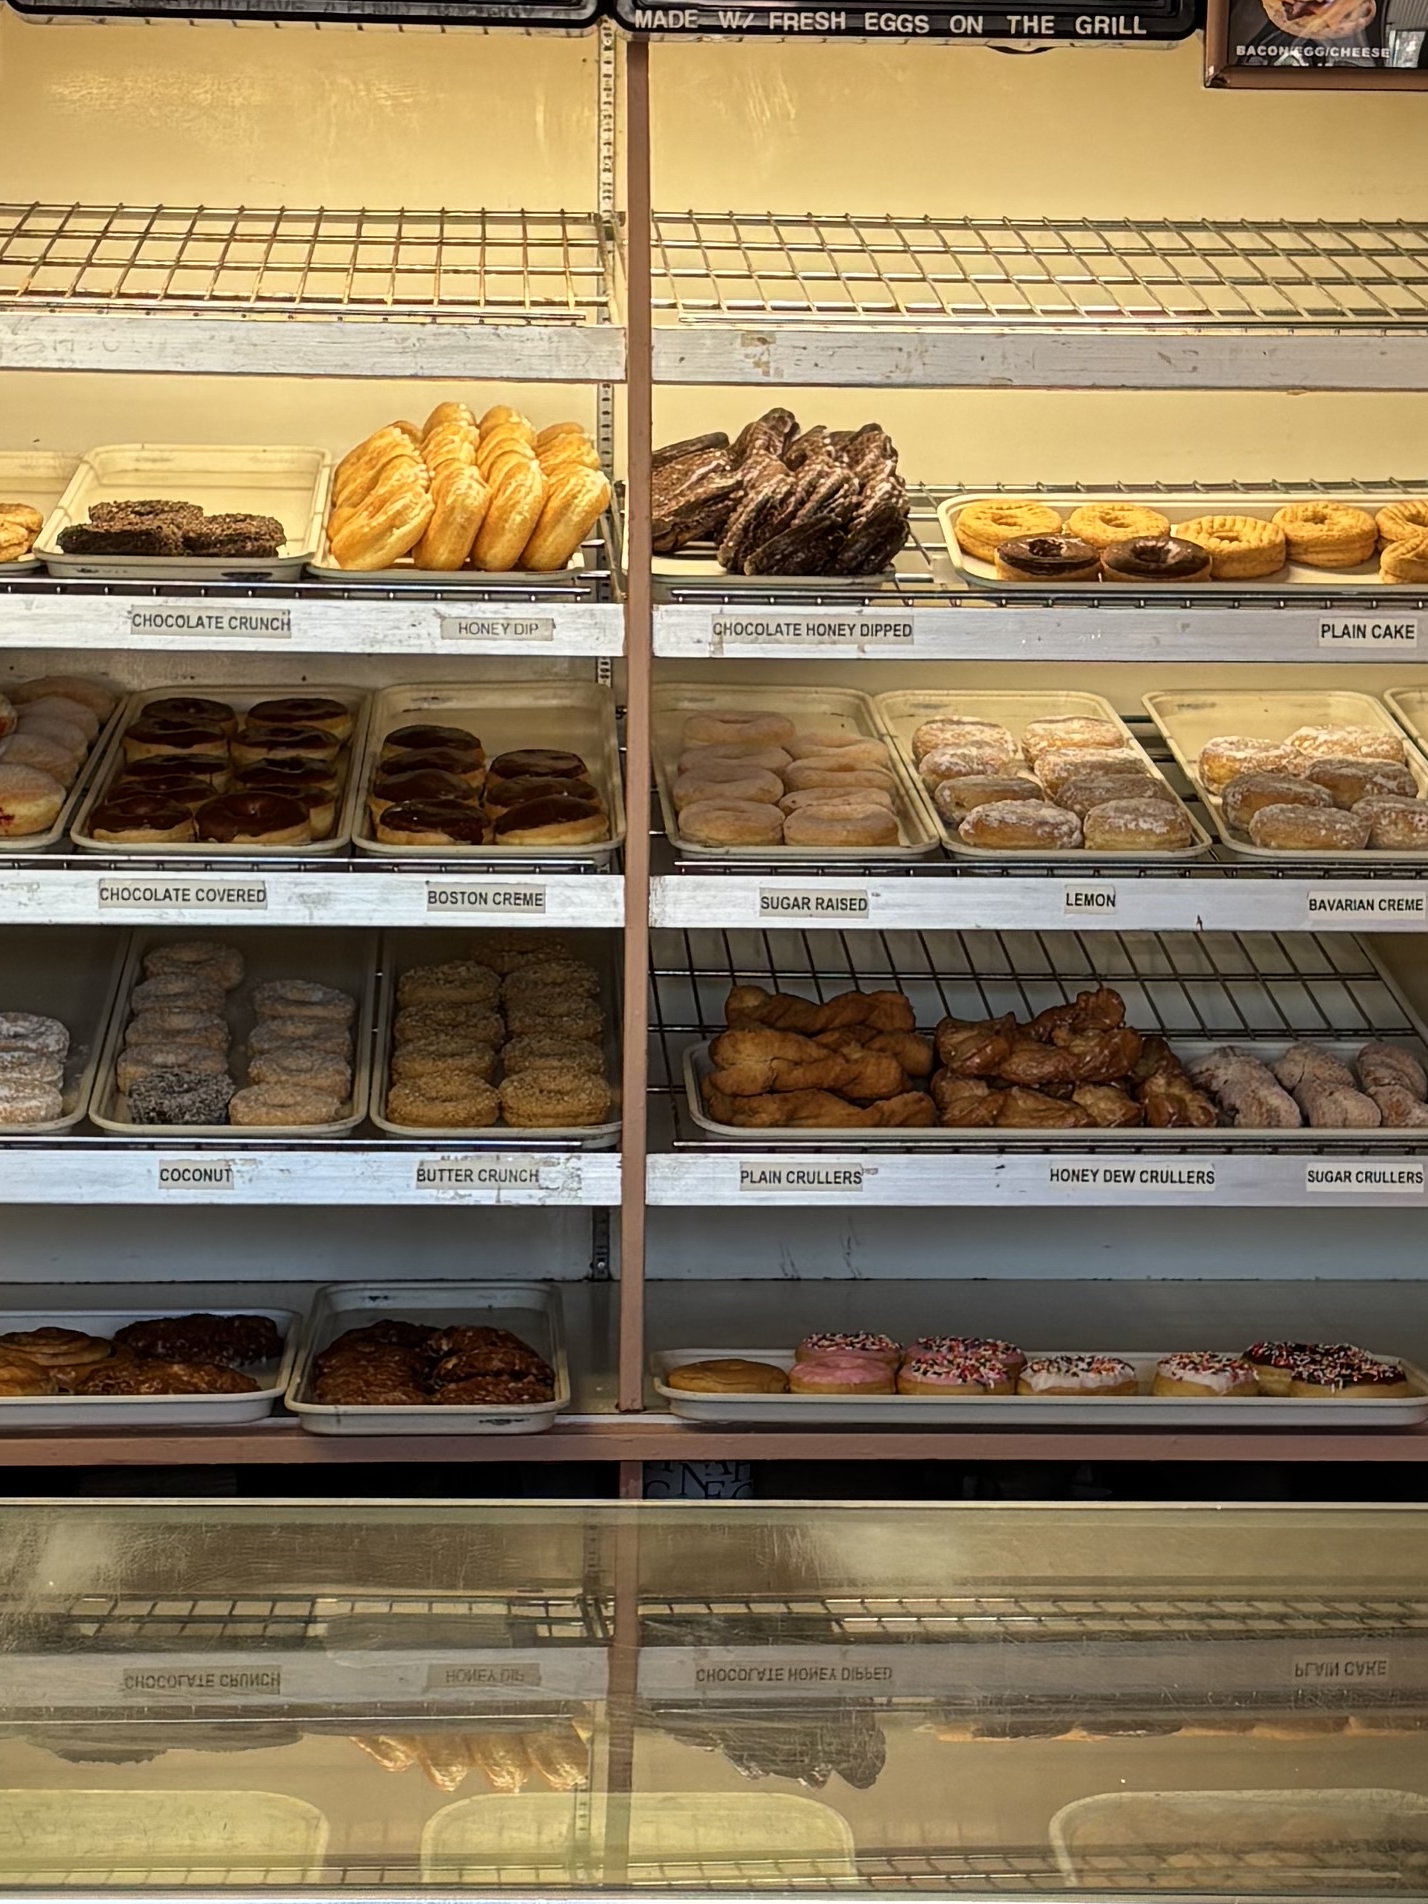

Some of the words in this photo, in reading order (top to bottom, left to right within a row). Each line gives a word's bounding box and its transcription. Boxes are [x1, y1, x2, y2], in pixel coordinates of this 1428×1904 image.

[635, 9, 698, 30] MADE
[769, 10, 846, 31] FRESH
[864, 12, 929, 34] EGGS
[949, 13, 983, 35] ON
[1007, 15, 1055, 35] THE
[1075, 16, 1147, 36] GRILL
[132, 613, 224, 630] CHOCOLATE
[228, 614, 291, 632] CRUNCH
[458, 621, 509, 635] HONEY
[514, 622, 539, 636] DIP
[713, 621, 802, 637] CHOCOLATE
[805, 622, 856, 638] HONEY
[860, 623, 913, 639] DIPPED
[1321, 624, 1366, 640] PLAIN
[1372, 624, 1415, 640] CAKE
[99, 887, 191, 903] CHOCOLATE
[195, 887, 266, 903] COVERED
[427, 890, 488, 906] BOSTON
[492, 891, 544, 907] CREME
[1066, 893, 1116, 907] LEMON
[760, 896, 811, 911] SUGAR
[815, 896, 868, 912] RAISED
[1309, 898, 1374, 911] BAVARIAN
[1378, 899, 1424, 911] CREME
[160, 1168, 232, 1182] COCONUT
[416, 1168, 474, 1182] BUTTER
[478, 1168, 539, 1182] CRUNCH
[740, 1171, 782, 1184] PLAIN
[786, 1171, 862, 1184] CRULLERS
[1050, 1168, 1099, 1183] HONEY
[1103, 1169, 1136, 1183] DEW
[1139, 1170, 1215, 1184] CRULLERS
[1307, 1170, 1352, 1183] SUGAR
[1355, 1171, 1423, 1184] CRULLERS
